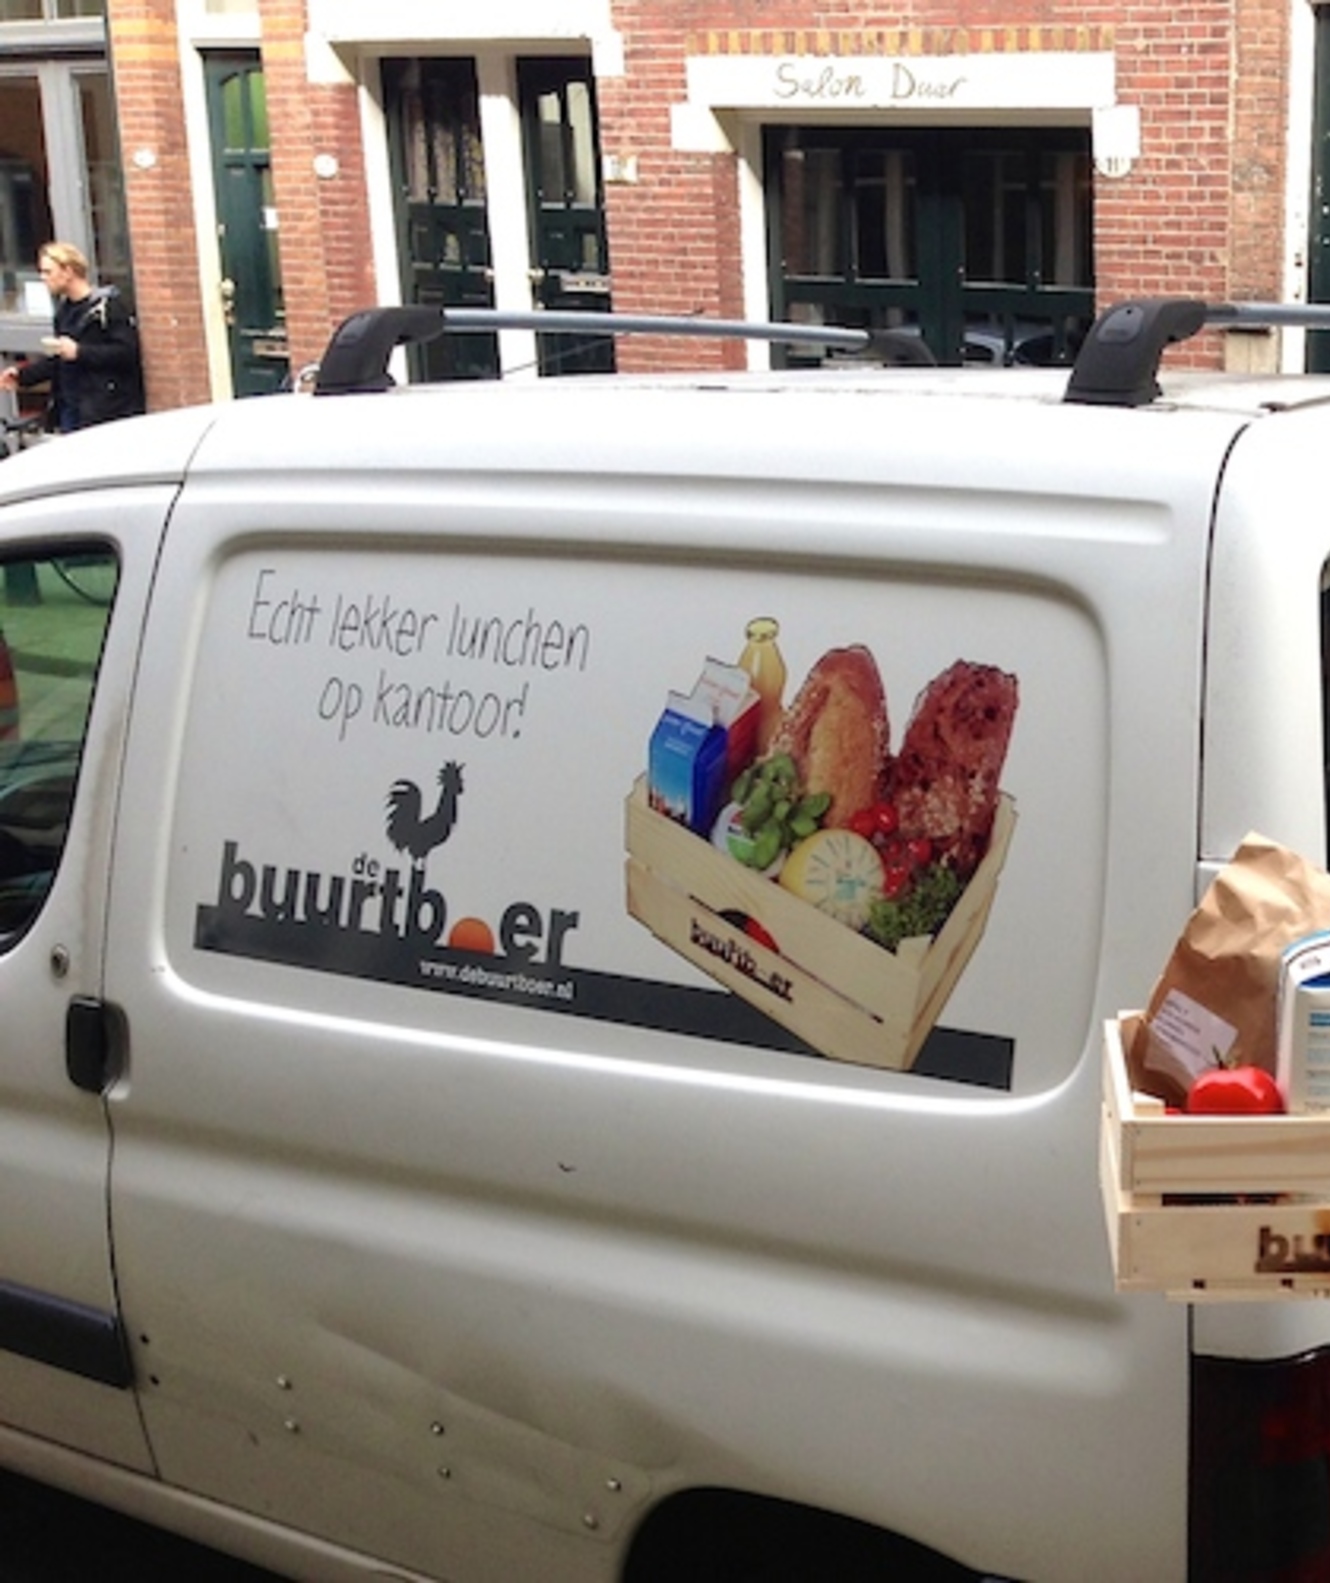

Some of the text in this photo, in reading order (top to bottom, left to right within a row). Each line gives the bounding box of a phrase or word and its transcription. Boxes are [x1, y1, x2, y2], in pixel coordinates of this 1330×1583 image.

[248, 569, 591, 672] Echt lekker lunchen
[318, 668, 530, 742] op kantoor!
[352, 853, 381, 879] de
[419, 959, 575, 1000] www.debuurtboer.nl
